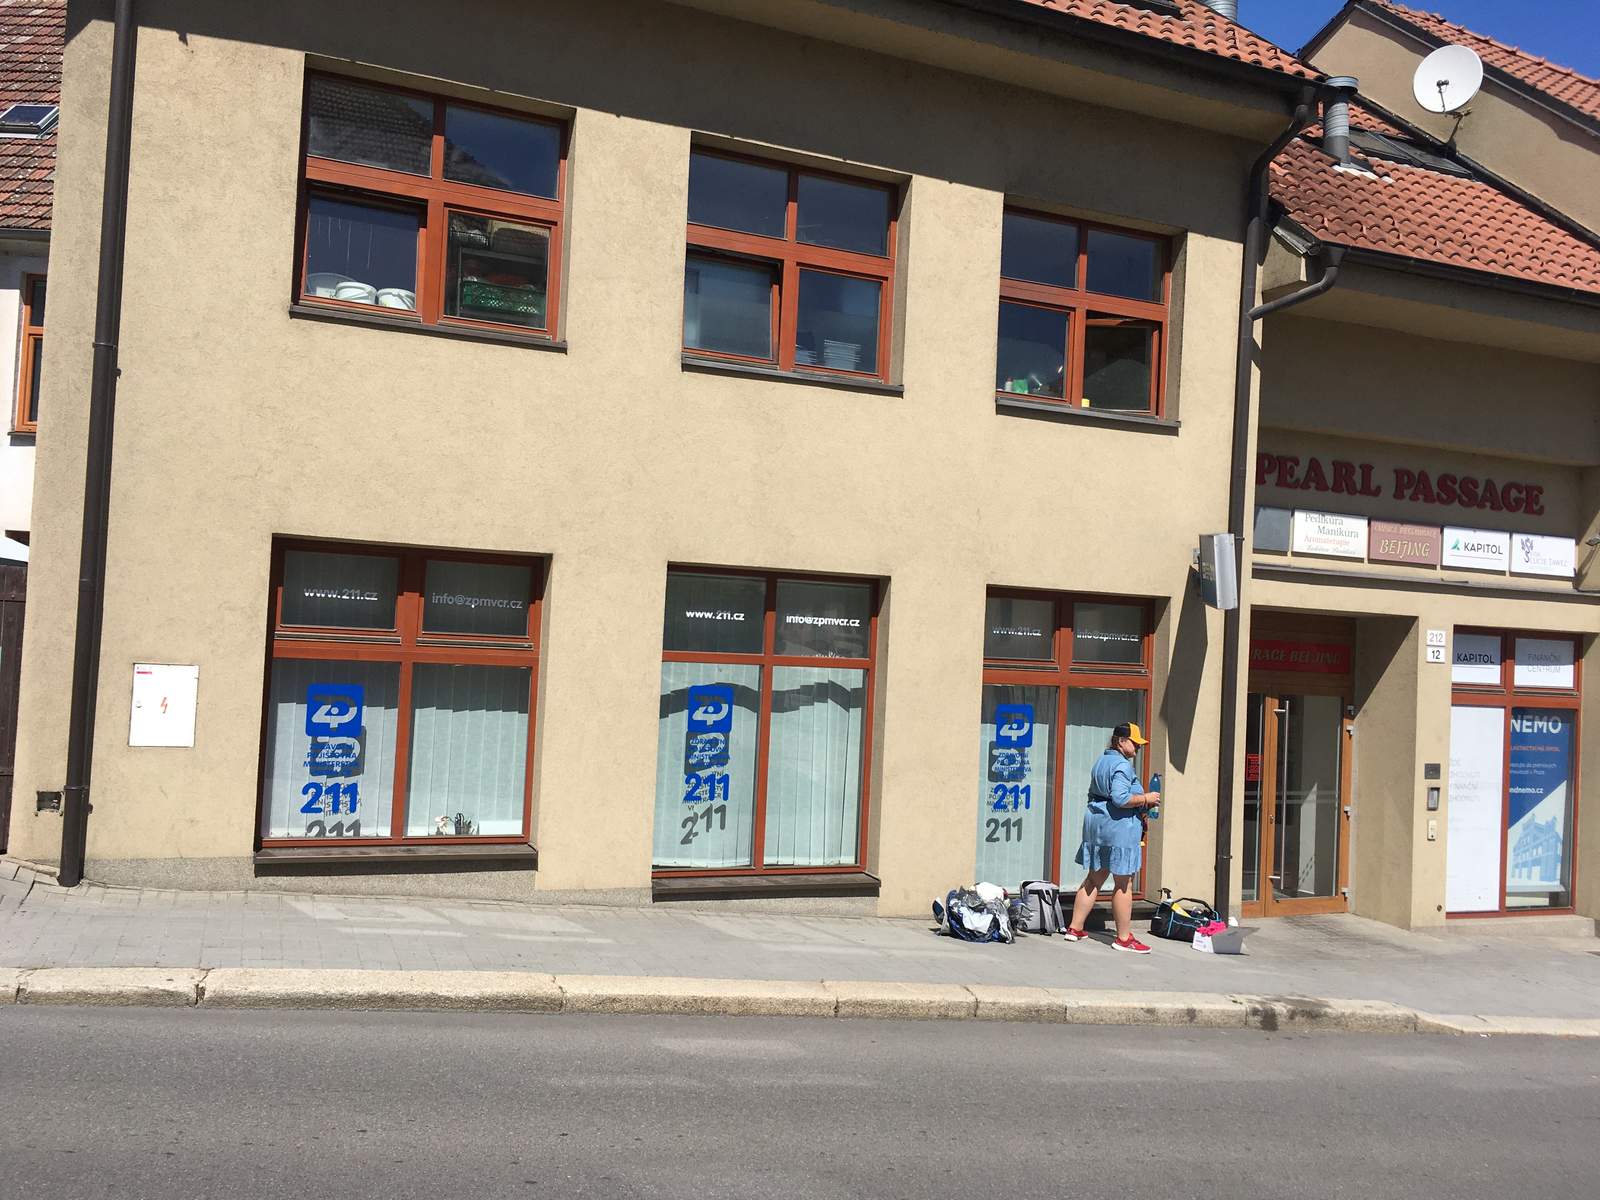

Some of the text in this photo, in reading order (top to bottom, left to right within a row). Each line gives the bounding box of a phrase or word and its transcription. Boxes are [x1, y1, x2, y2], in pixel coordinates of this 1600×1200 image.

[1256, 452, 1545, 517] PEARL PASSAGE
[1379, 538, 1432, 559] BEIJING
[1463, 541, 1504, 555] KAPITOL
[303, 587, 378, 601] www.211.cz
[431, 592, 523, 609] info@zpmvcr.cz
[685, 610, 745, 621] www.211.cz
[1428, 632, 1444, 643] 212
[1431, 649, 1441, 660] 12
[1456, 651, 1496, 664] KAPITOL
[1510, 714, 1562, 734] NEMO
[682, 773, 730, 802] 211
[300, 782, 359, 814] 211
[993, 784, 1032, 811] 211
[985, 817, 1023, 843] 211
